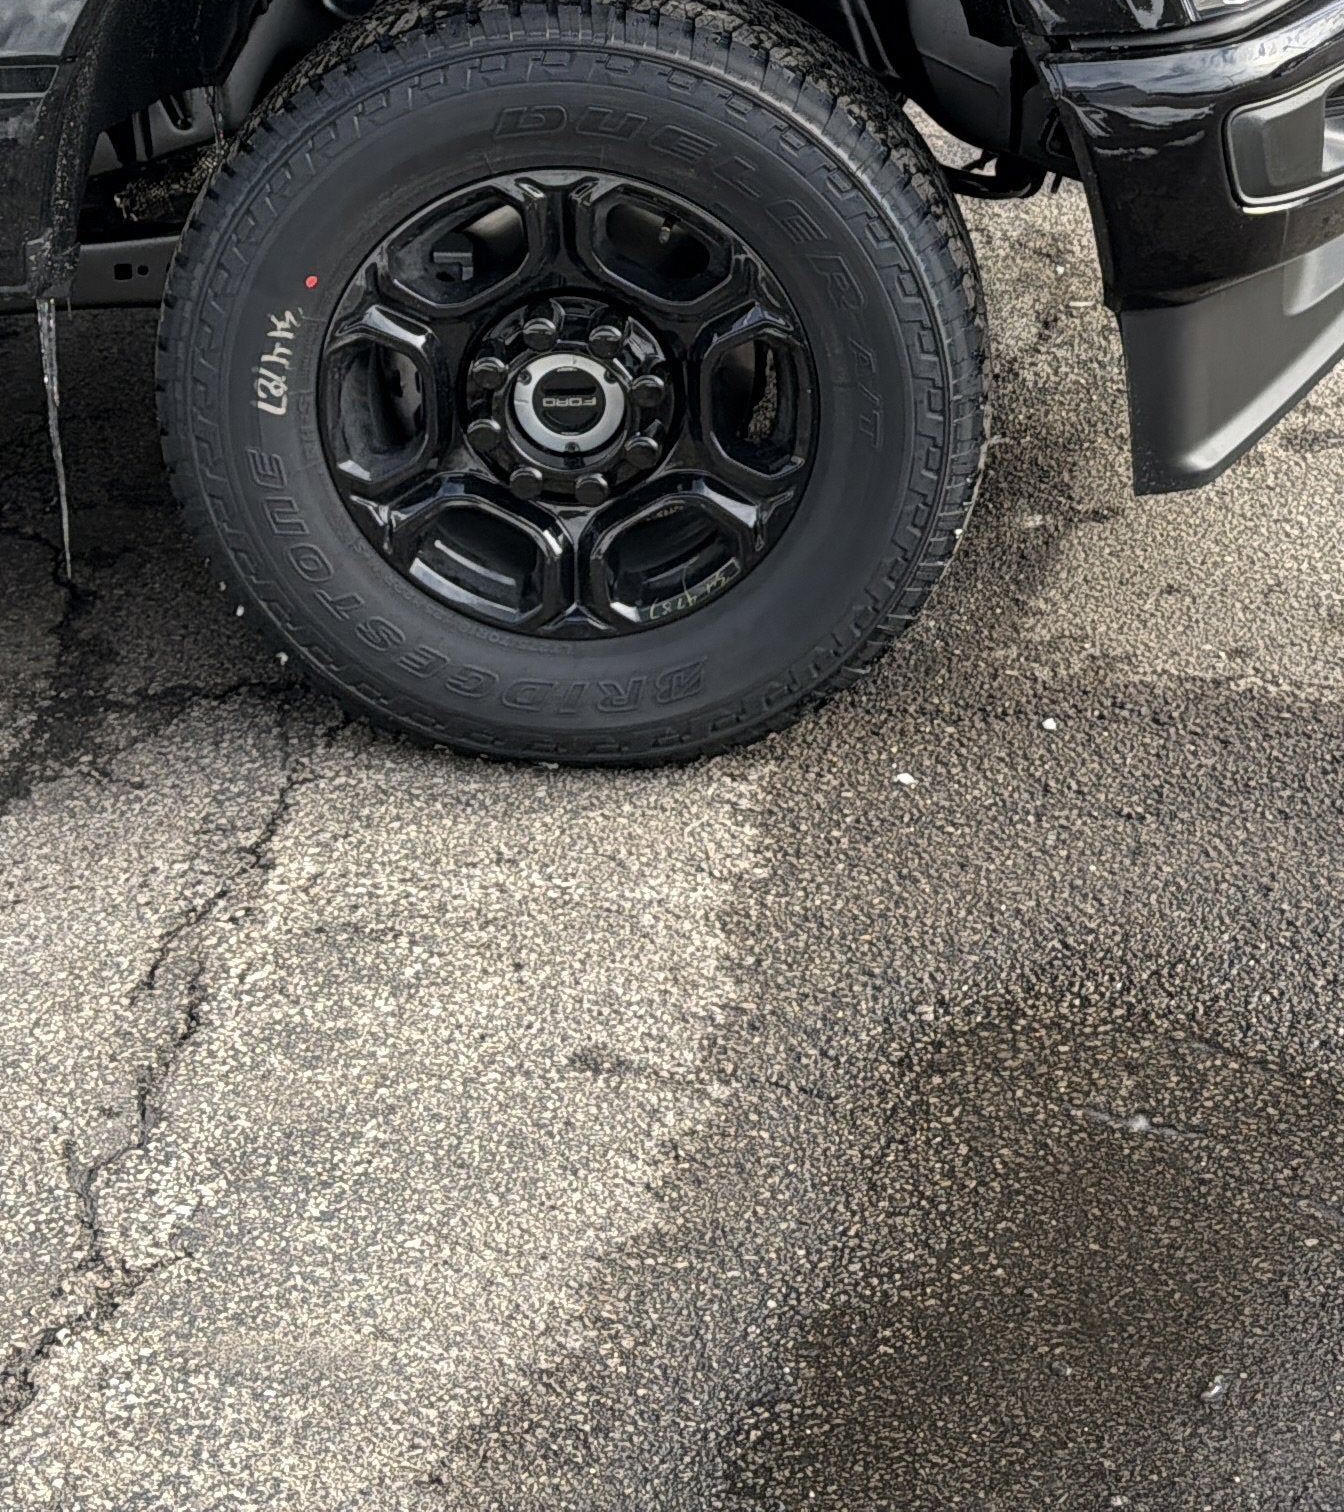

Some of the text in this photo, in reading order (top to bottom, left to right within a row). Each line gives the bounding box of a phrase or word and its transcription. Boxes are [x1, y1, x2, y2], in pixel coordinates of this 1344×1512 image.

[493, 103, 884, 450] DUELER A/T
[542, 397, 597, 407] FORD
[247, 448, 707, 714] BRIDGESTONE
